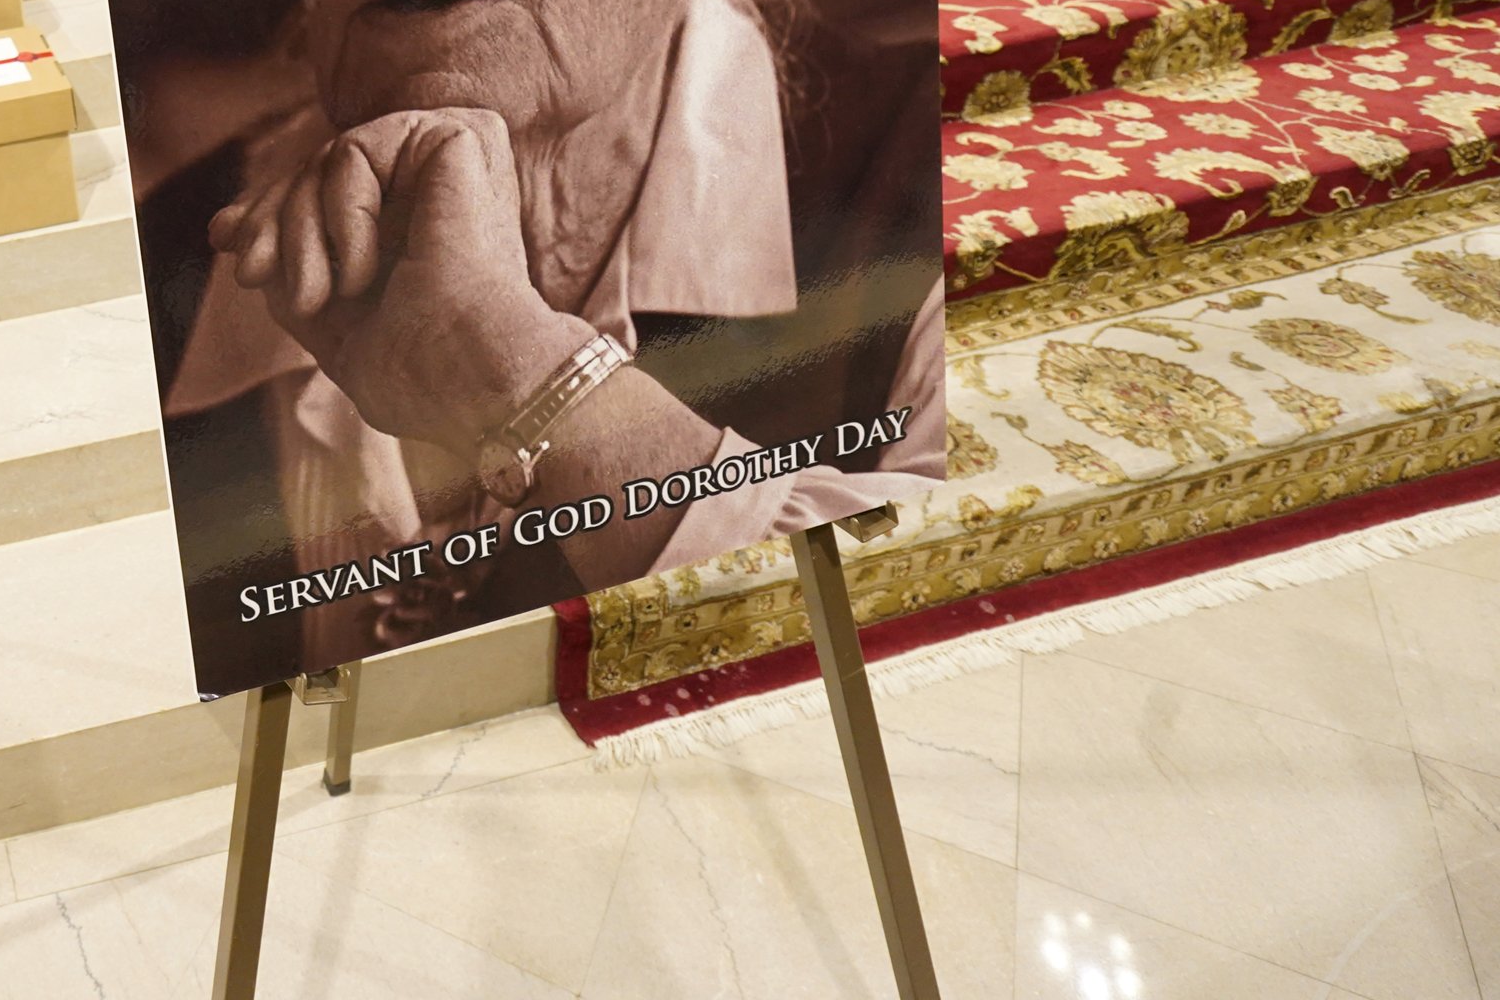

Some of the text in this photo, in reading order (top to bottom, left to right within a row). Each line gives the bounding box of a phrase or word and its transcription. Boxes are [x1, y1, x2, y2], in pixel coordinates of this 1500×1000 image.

[239, 409, 910, 623] SERVANT OF GOD DOROTHY DAY
